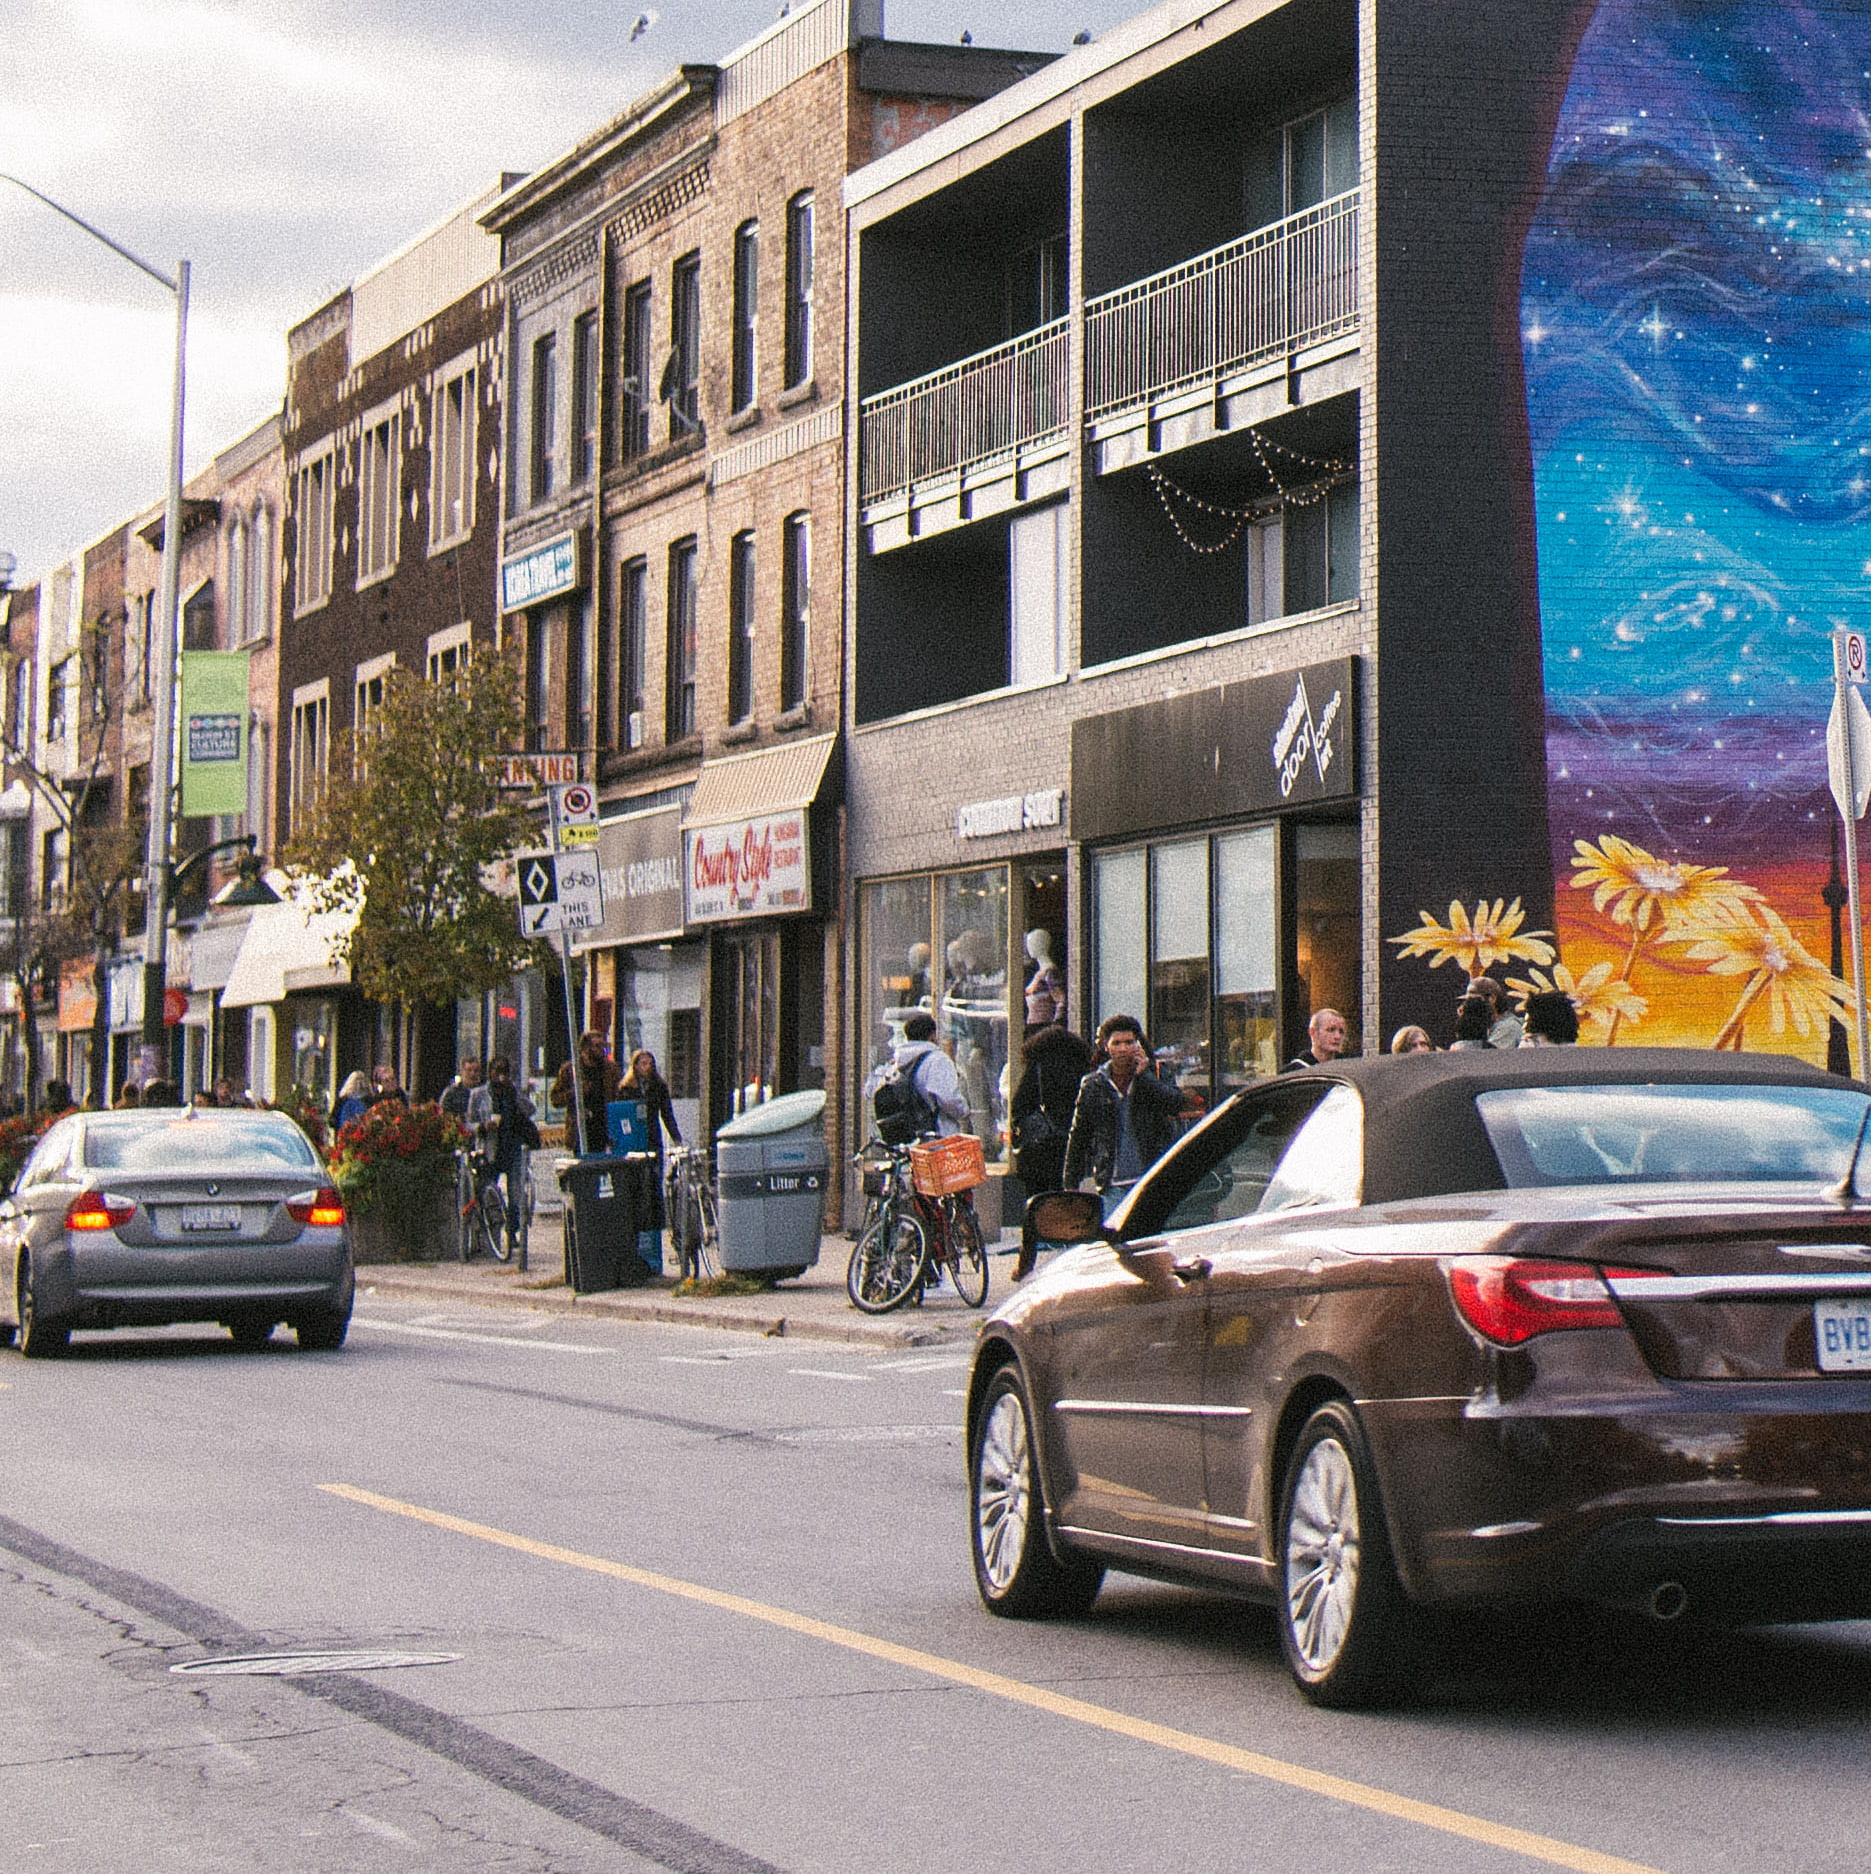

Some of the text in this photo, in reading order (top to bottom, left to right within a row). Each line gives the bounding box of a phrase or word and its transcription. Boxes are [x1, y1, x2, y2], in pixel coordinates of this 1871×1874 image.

[694, 833, 741, 906] Country
[741, 823, 773, 904] Style
[561, 901, 589, 914] THIS
[561, 914, 594, 929] LANE
[770, 1175, 800, 1191] Litter
